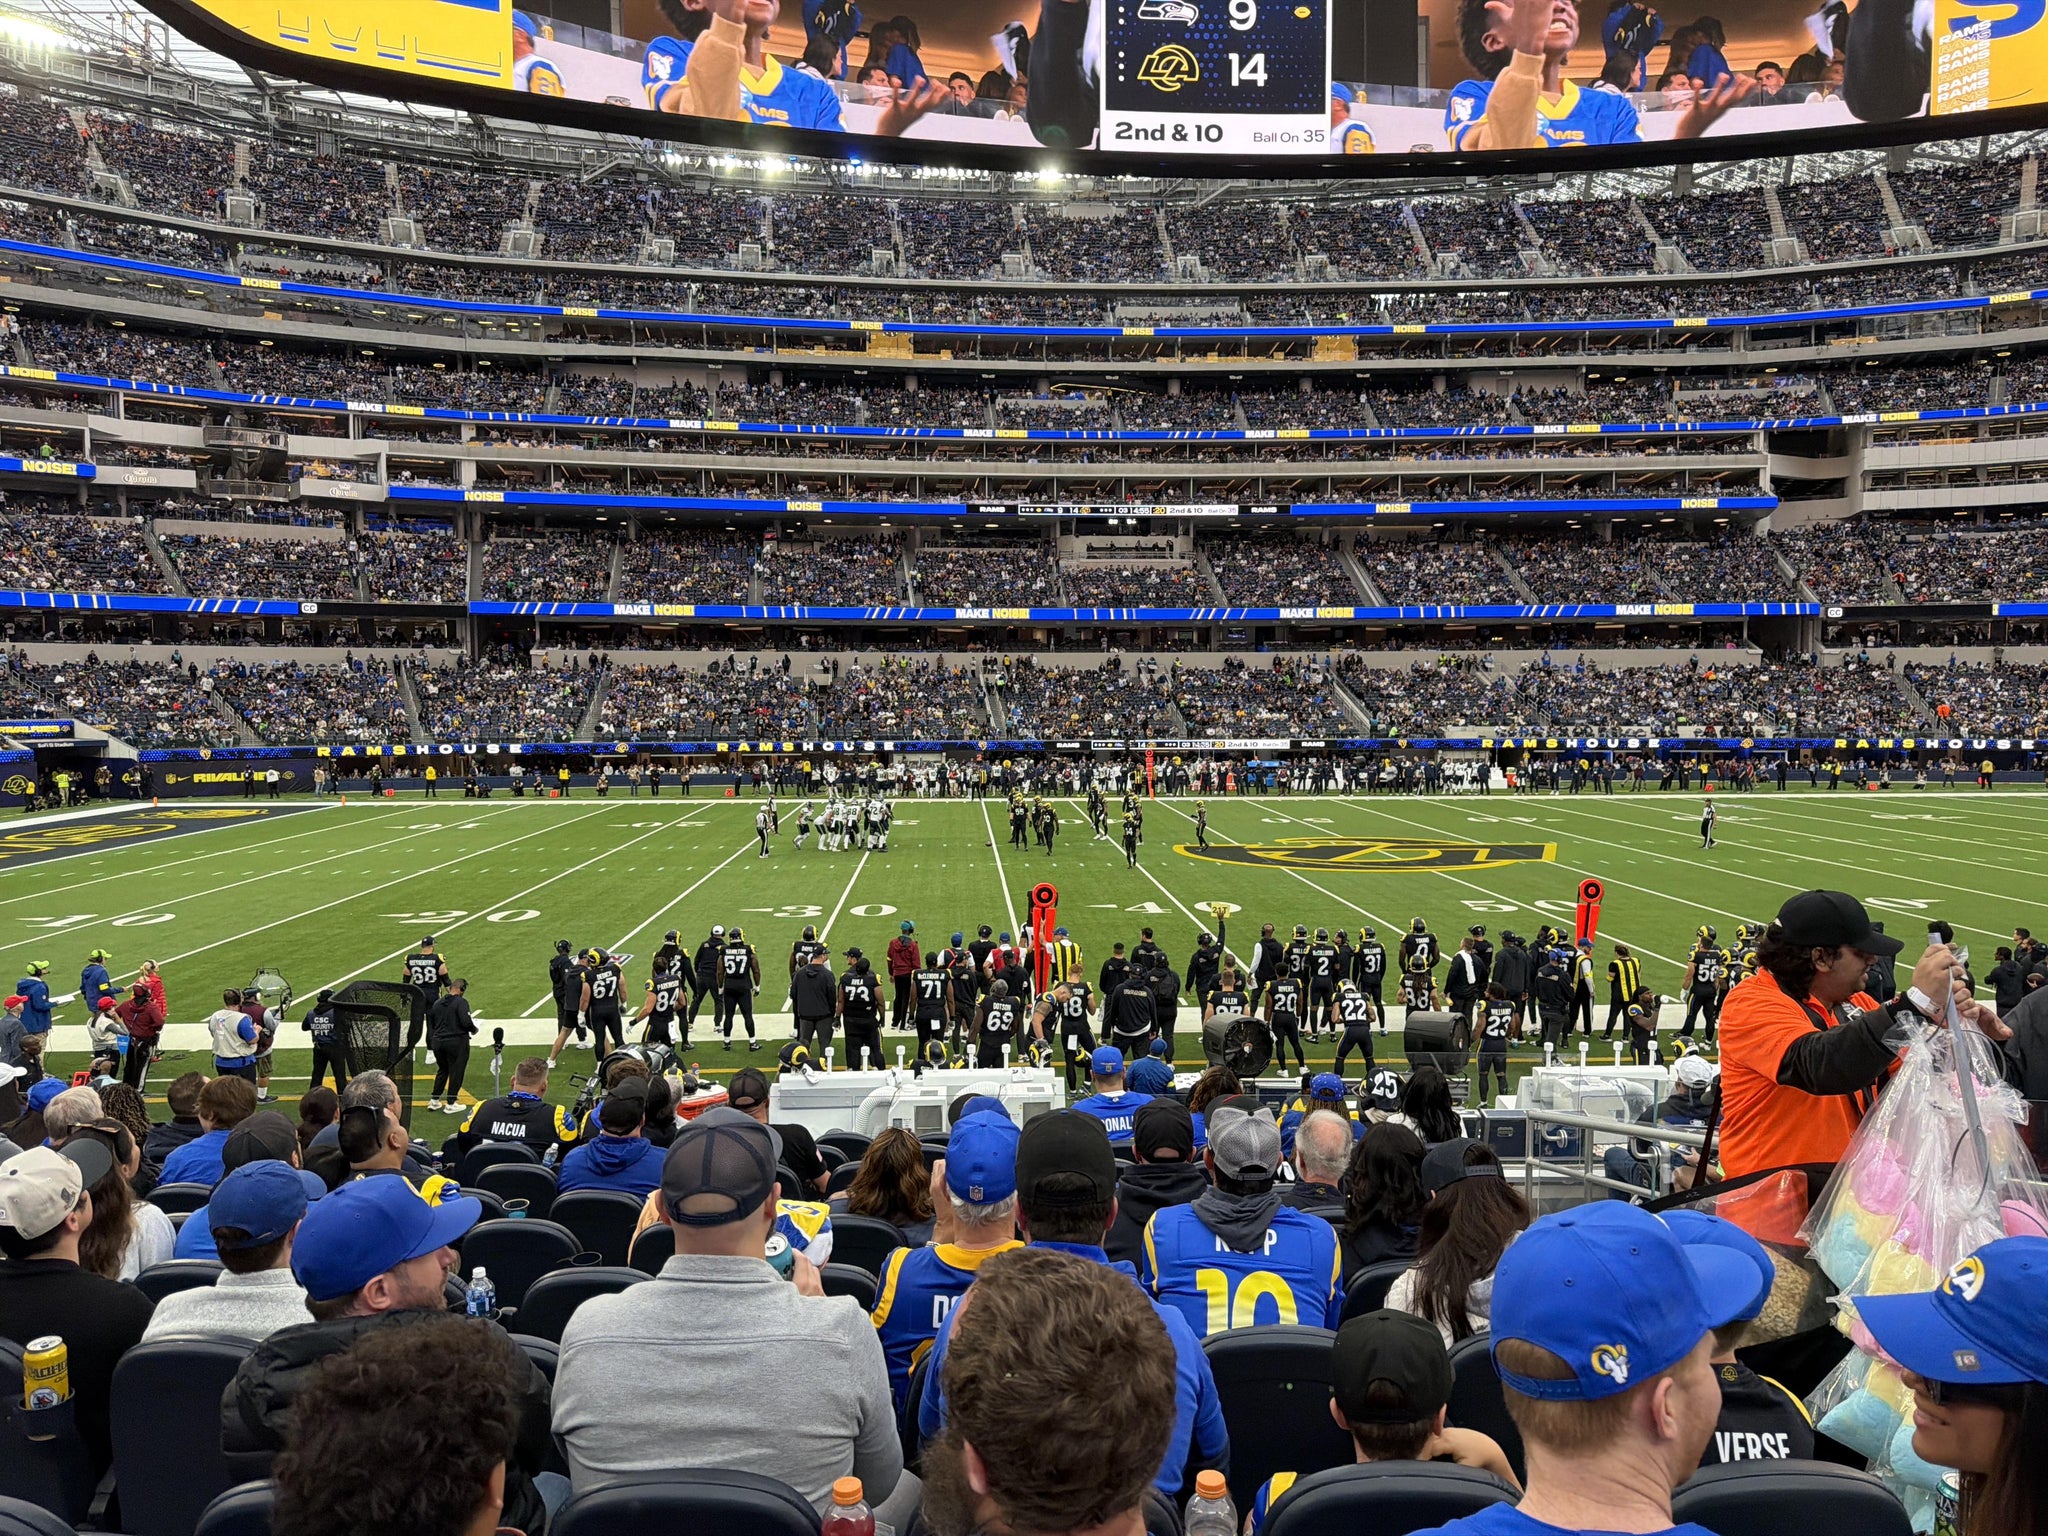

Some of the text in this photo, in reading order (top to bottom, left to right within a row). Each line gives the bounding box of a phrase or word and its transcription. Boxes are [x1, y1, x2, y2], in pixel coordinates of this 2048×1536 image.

[1938, 19, 1992, 45] RAMS
[1938, 39, 1990, 65] RAMS
[1229, 53, 1268, 87] 14
[1938, 49, 1990, 75] RAMS
[1937, 68, 1989, 94] RAMS
[1937, 78, 1989, 104] RAMS
[750, 103, 789, 120] AMS
[1114, 121, 1224, 143] 2nd & 10
[1253, 129, 1326, 144] Ball On 35
[1547, 129, 1585, 141] AMS
[347, 401, 383, 412] MAKE
[670, 420, 701, 429] MAKE
[1842, 414, 1877, 424] MAKE
[964, 429, 993, 437] MAKE
[1245, 430, 1274, 438] MAKE
[1533, 425, 1565, 433] MAKE
[22, 460, 77, 475] NOISE!
[464, 491, 504, 502] NOISE!
[1681, 498, 1718, 509] NOISE!
[787, 501, 822, 512] NOISE!
[1376, 503, 1411, 514] NOISE!
[614, 604, 651, 616] MAKE
[955, 608, 990, 619] MAKE
[1280, 607, 1313, 618] MAKE
[1616, 604, 1651, 615] MAKE
[317, 744, 522, 757] RAMS HOUSE
[717, 741, 895, 752] RAMS HOUSE
[1482, 738, 1660, 749] RAMS HOUSE
[1835, 738, 2035, 750] RAMS HOUSE
[773, 903, 898, 918] 30
[724, 955, 748, 974] 57
[1318, 957, 1329, 976] 2
[1365, 955, 1382, 973] 31
[411, 966, 437, 985] 68
[592, 976, 618, 999] 67
[845, 986, 870, 1002] 73
[921, 981, 942, 998] 71
[655, 988, 679, 1012] 84
[993, 1003, 1012, 1011] DOTSON
[1063, 996, 1083, 1017] 18
[1274, 993, 1298, 1012] 20
[1342, 999, 1367, 1021] 22
[987, 1011, 1014, 1031] 69
[1486, 1016, 1512, 1037] 23
[1372, 1070, 1397, 1099] 25
[491, 1121, 526, 1138] NACUA
[1101, 1116, 1133, 1133] ONAL
[1196, 1268, 1299, 1337] 10
[1715, 1431, 1790, 1464] VERSE
